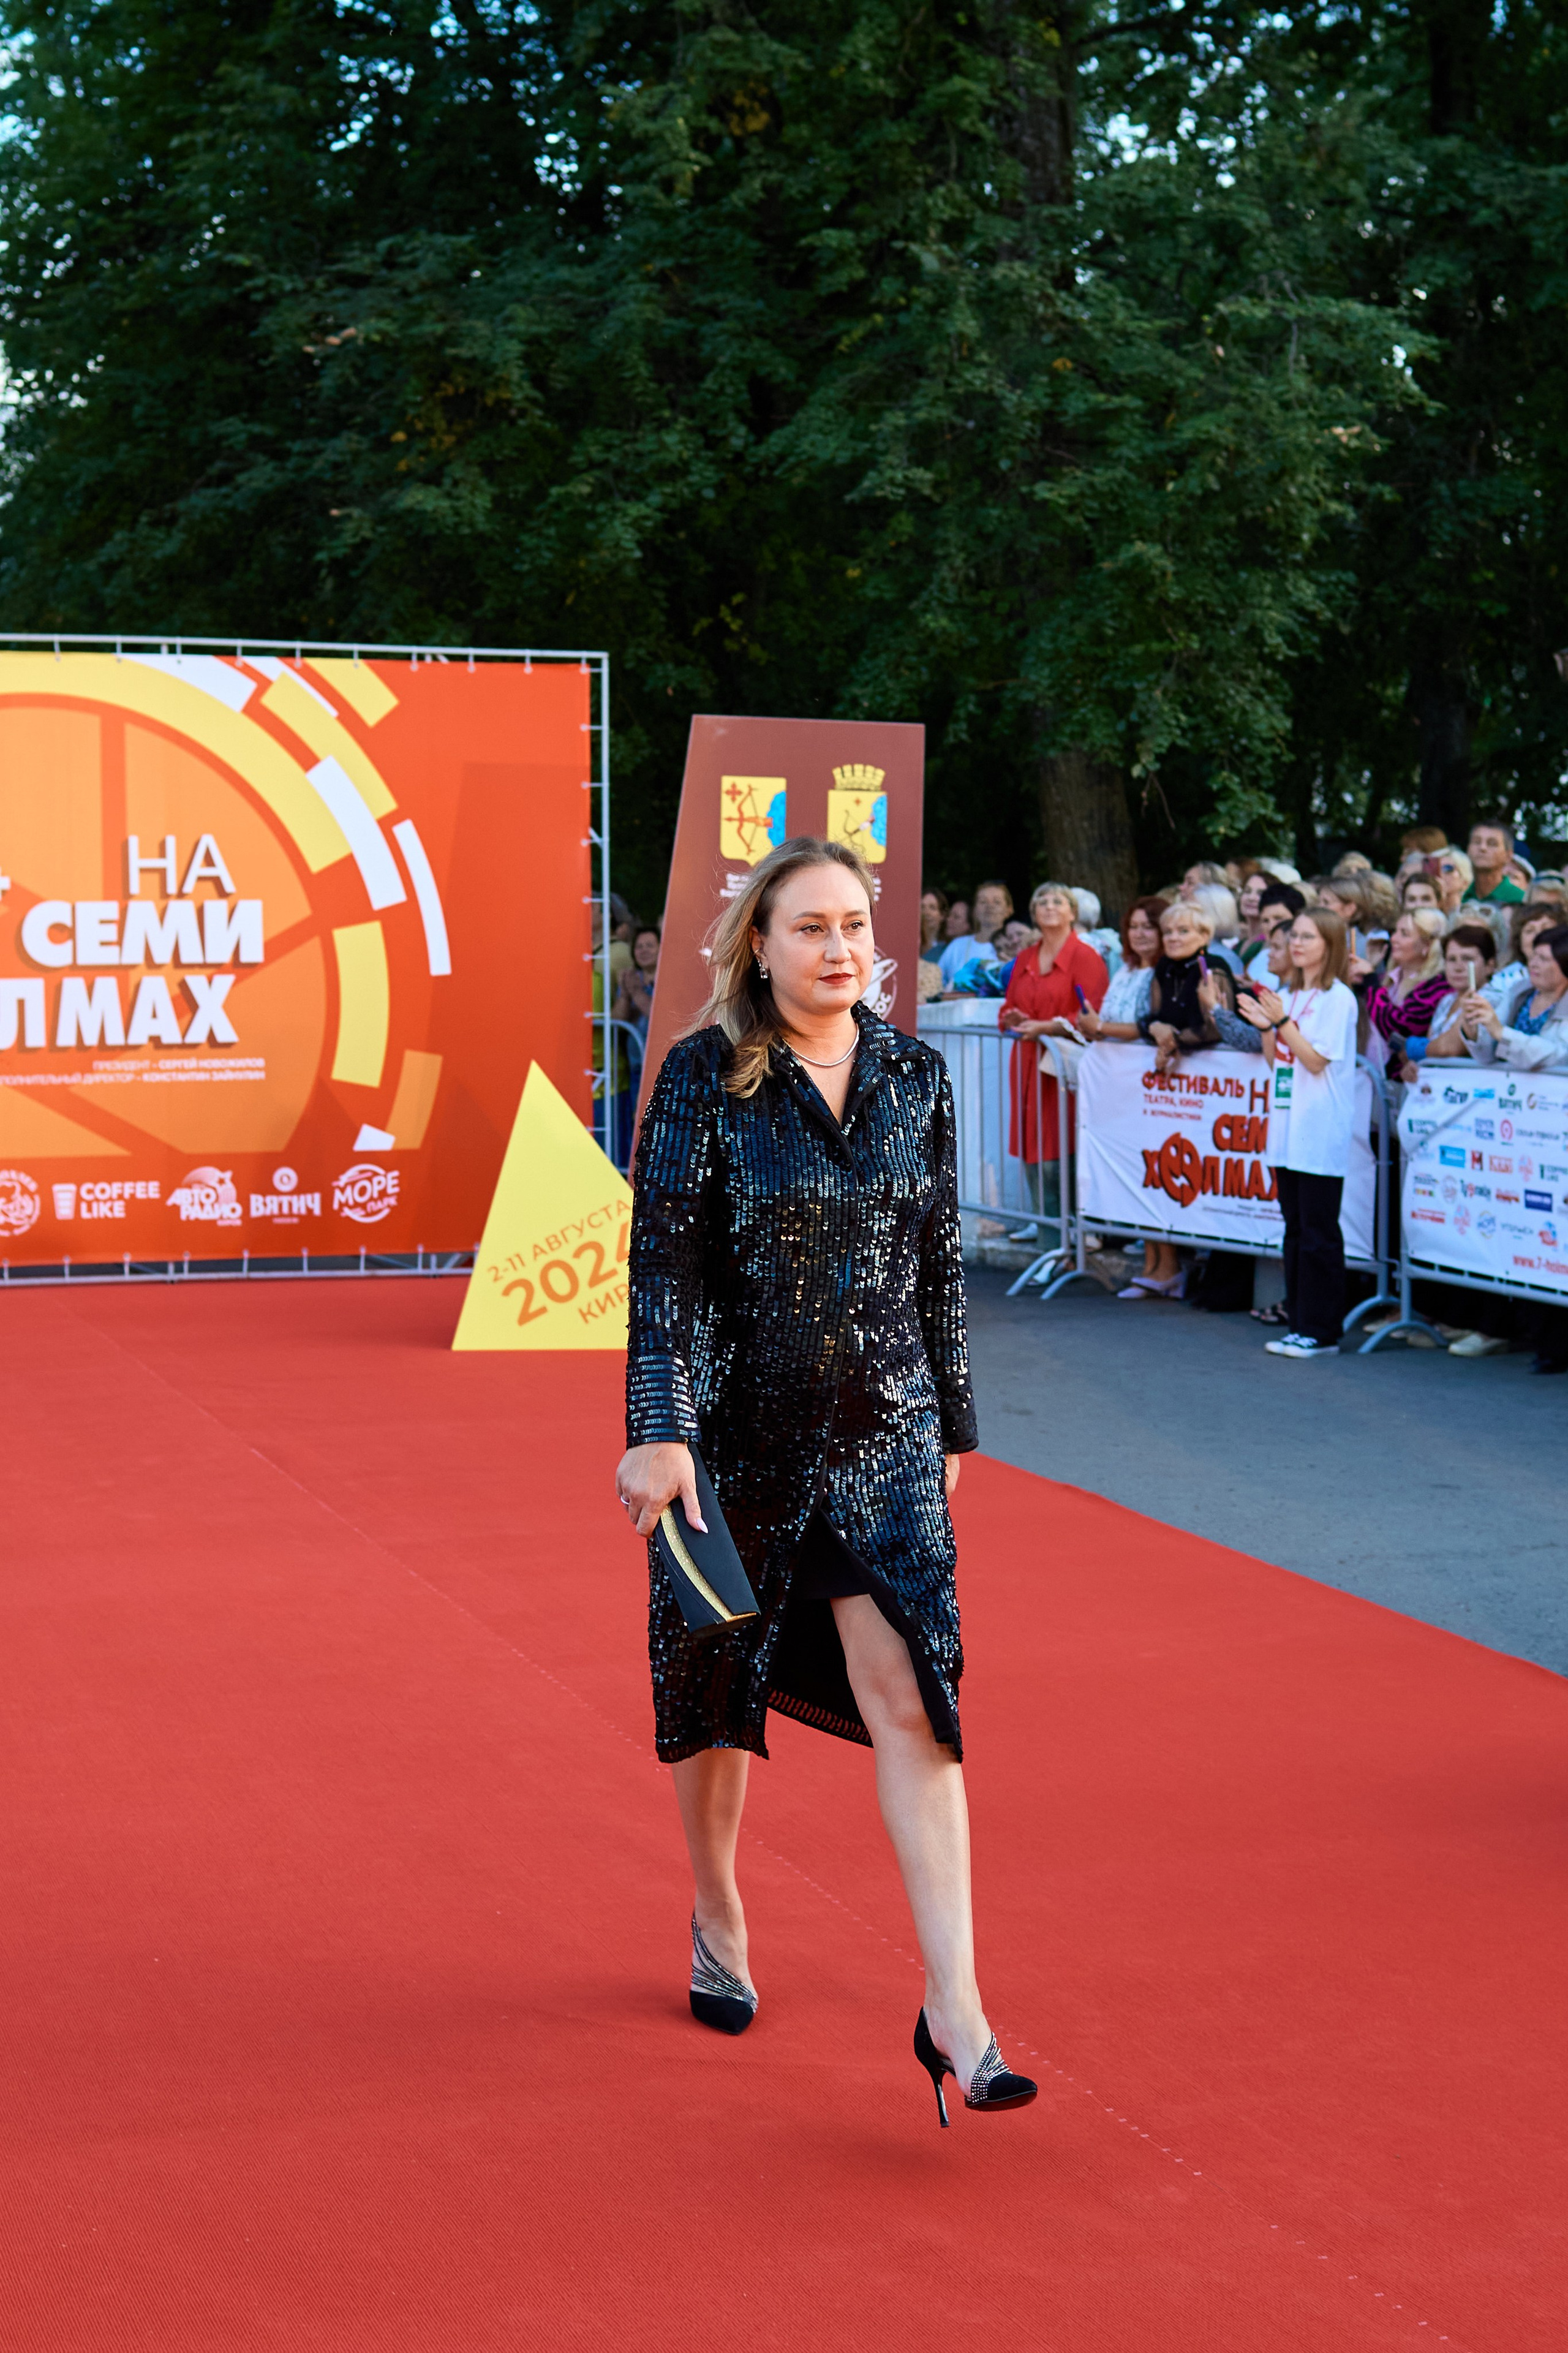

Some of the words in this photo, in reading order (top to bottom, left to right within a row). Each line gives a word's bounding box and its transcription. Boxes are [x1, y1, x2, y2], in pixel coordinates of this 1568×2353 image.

[128, 834, 236, 895] НА
[21, 899, 265, 967] СЕМИ
[0, 975, 239, 1049] ЛМАХ
[0, 1072, 82, 1085] ПОЛНИТЕЛЬНЫЙ
[158, 1057, 197, 1070] СЕРГЕЙ
[1142, 1071, 1245, 1098] ФЕСТИВАЛЬ
[1250, 1079, 1270, 1113] Н
[1212, 1113, 1268, 1155] СЕМ
[80, 1181, 160, 1200] COFFEE
[80, 1200, 126, 1219] LIKE
[165, 1187, 217, 1206] АВТО
[250, 1192, 321, 1218] ВЯТИЧ
[333, 1170, 400, 1210] МОРЕ
[180, 1201, 243, 1221] РАДИО
[486, 1253, 527, 1282] 2-11
[532, 1199, 631, 1261] АВГУСТА
[578, 1282, 630, 1324] КИР
